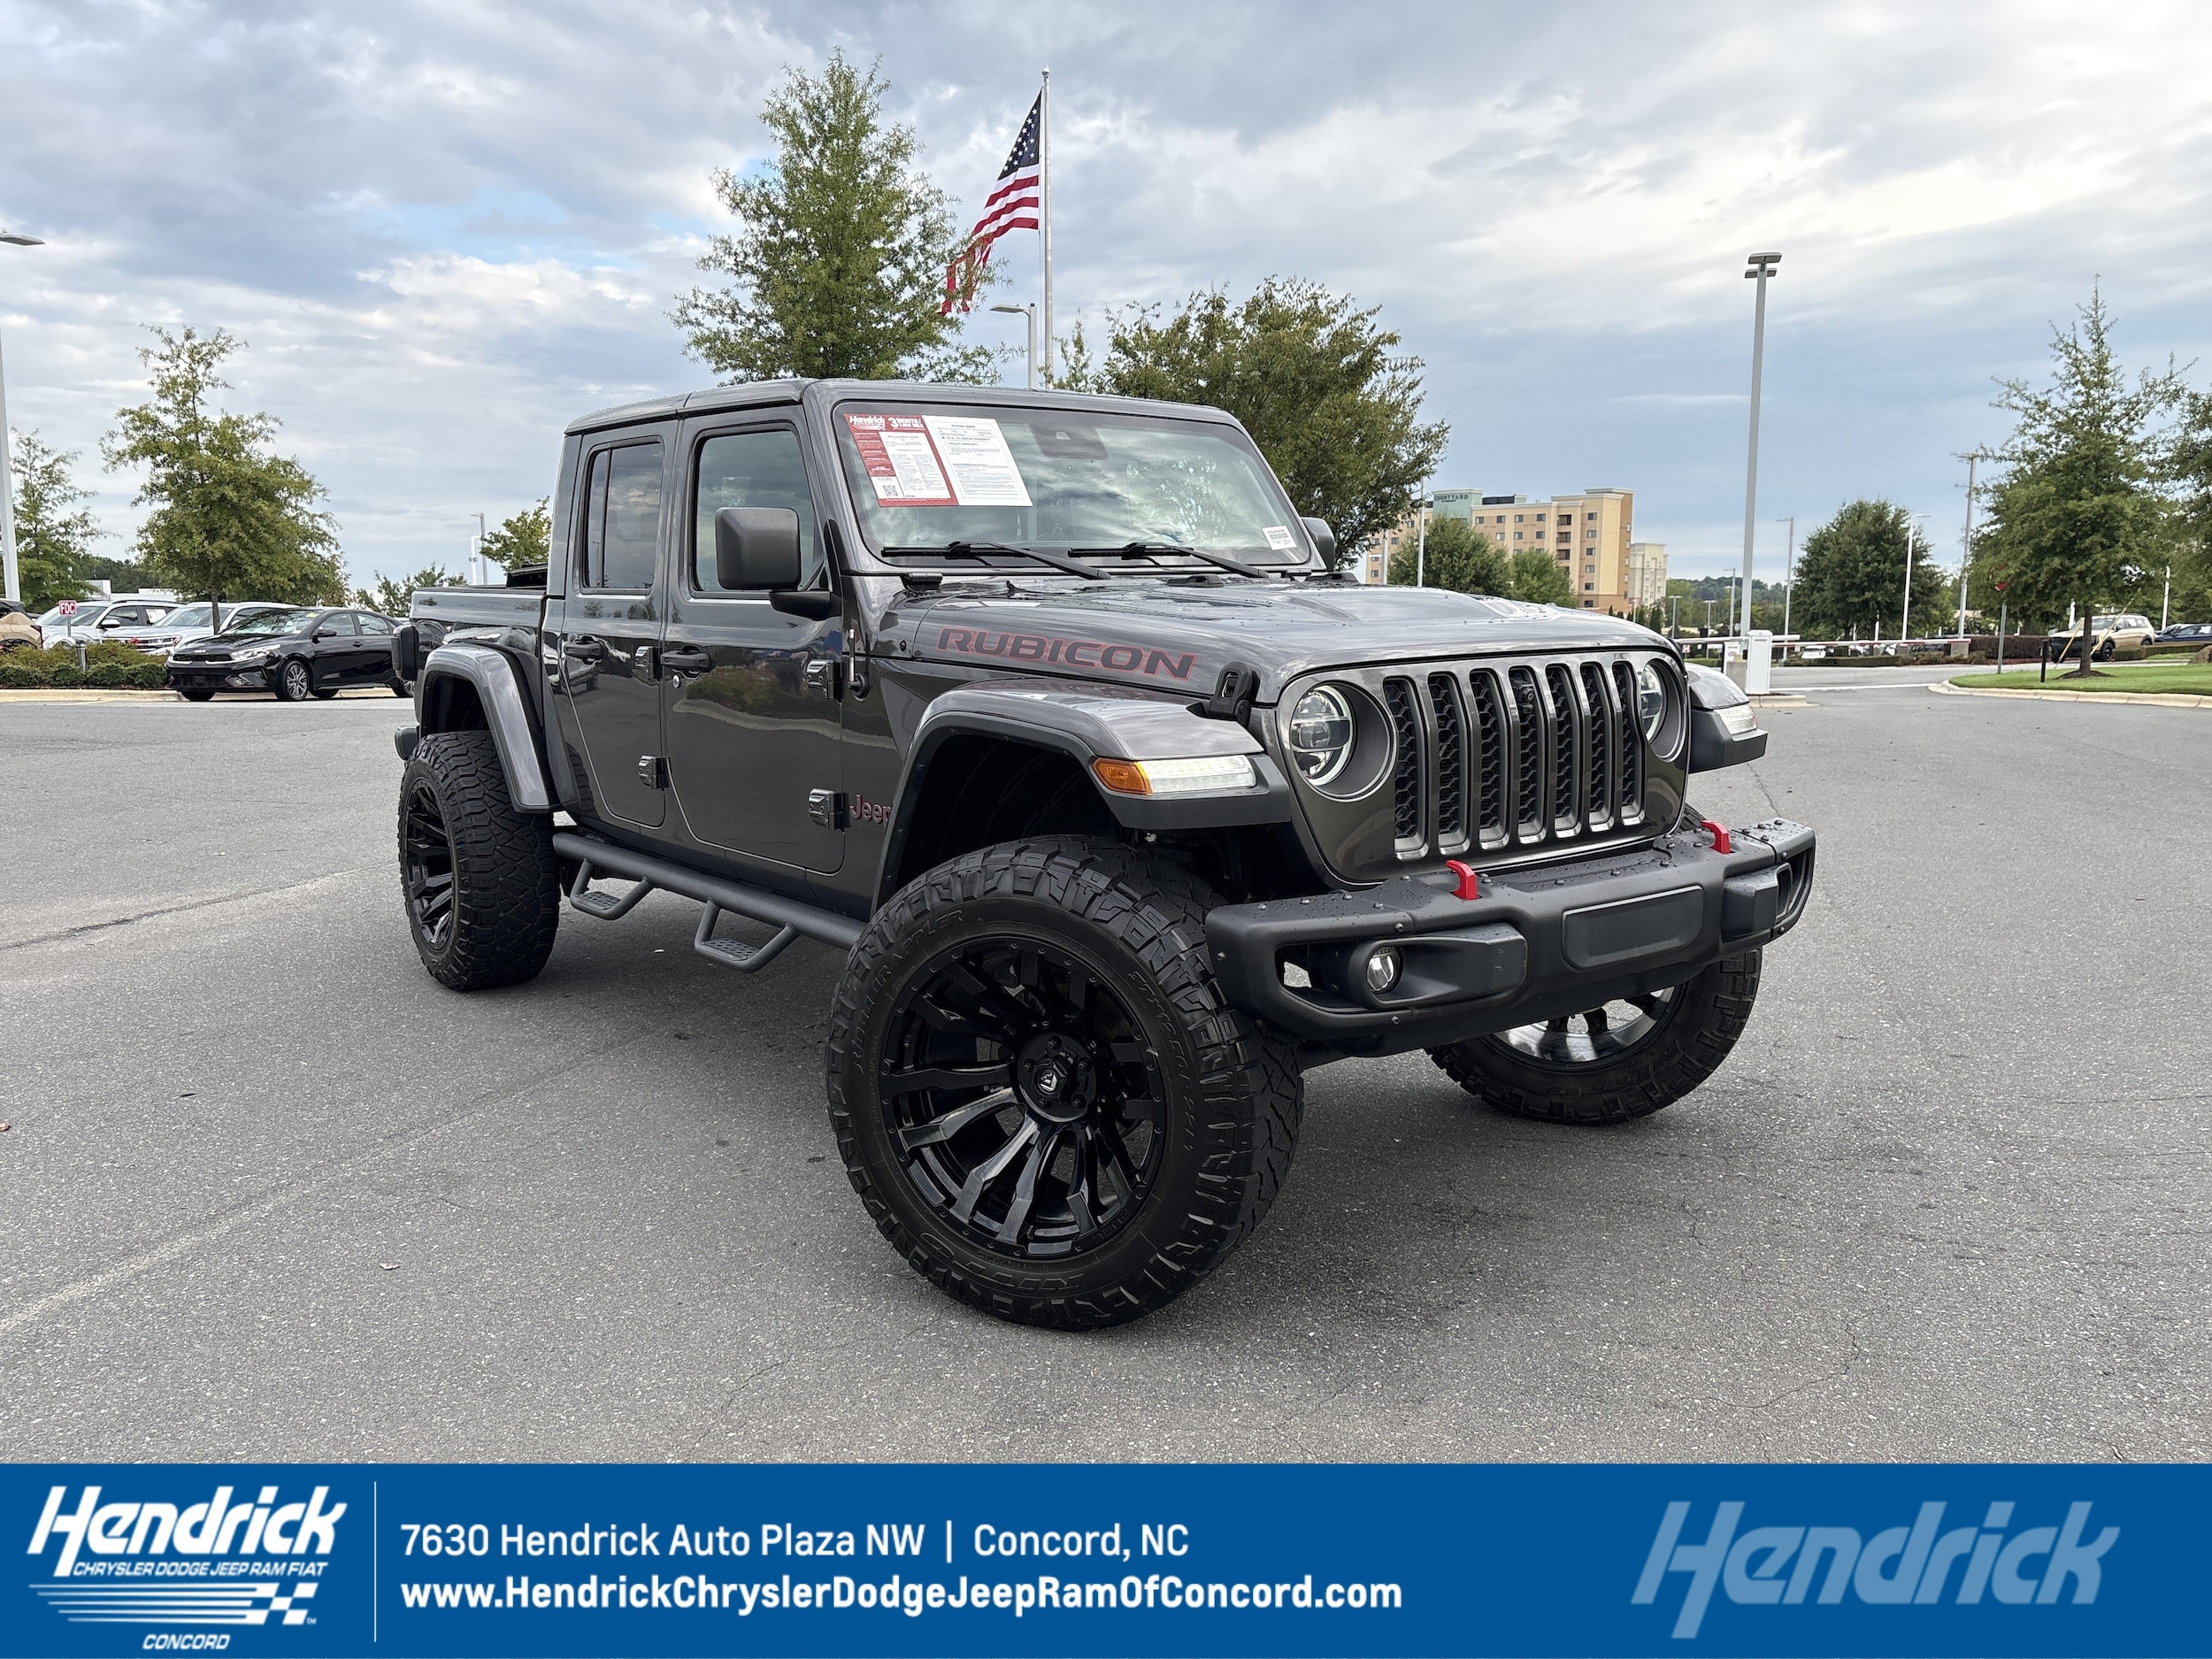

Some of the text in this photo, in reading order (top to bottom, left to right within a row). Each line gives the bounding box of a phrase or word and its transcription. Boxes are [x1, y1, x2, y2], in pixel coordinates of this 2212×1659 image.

[849, 415, 886, 426] Hendrick
[887, 417, 898, 428] 3
[61, 603, 75, 614] FDC
[936, 626, 1198, 681] RUBICON
